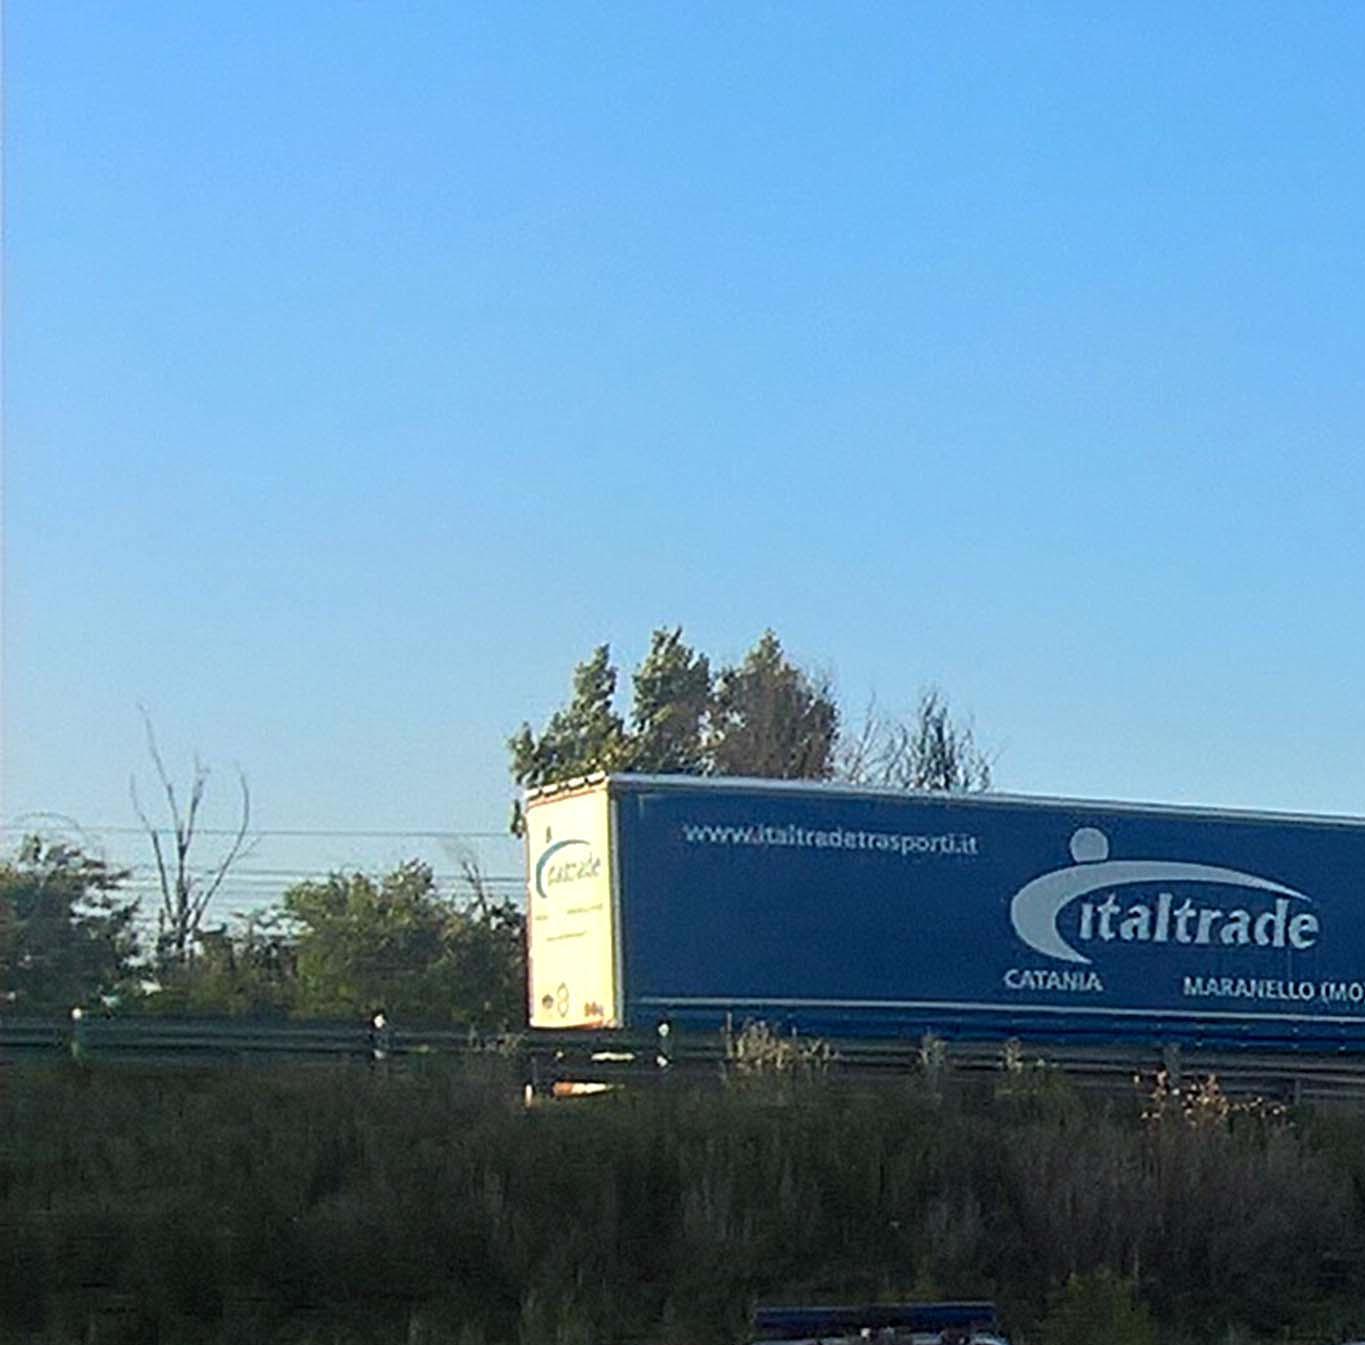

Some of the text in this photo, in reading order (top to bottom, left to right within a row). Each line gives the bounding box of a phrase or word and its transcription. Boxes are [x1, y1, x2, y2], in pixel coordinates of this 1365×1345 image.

[684, 823, 978, 855] www.italtradetrasporti.it
[1079, 893, 1319, 949] italtrade
[1004, 968, 1103, 991] CATANIA
[1184, 976, 1315, 1001] MARANELLO
